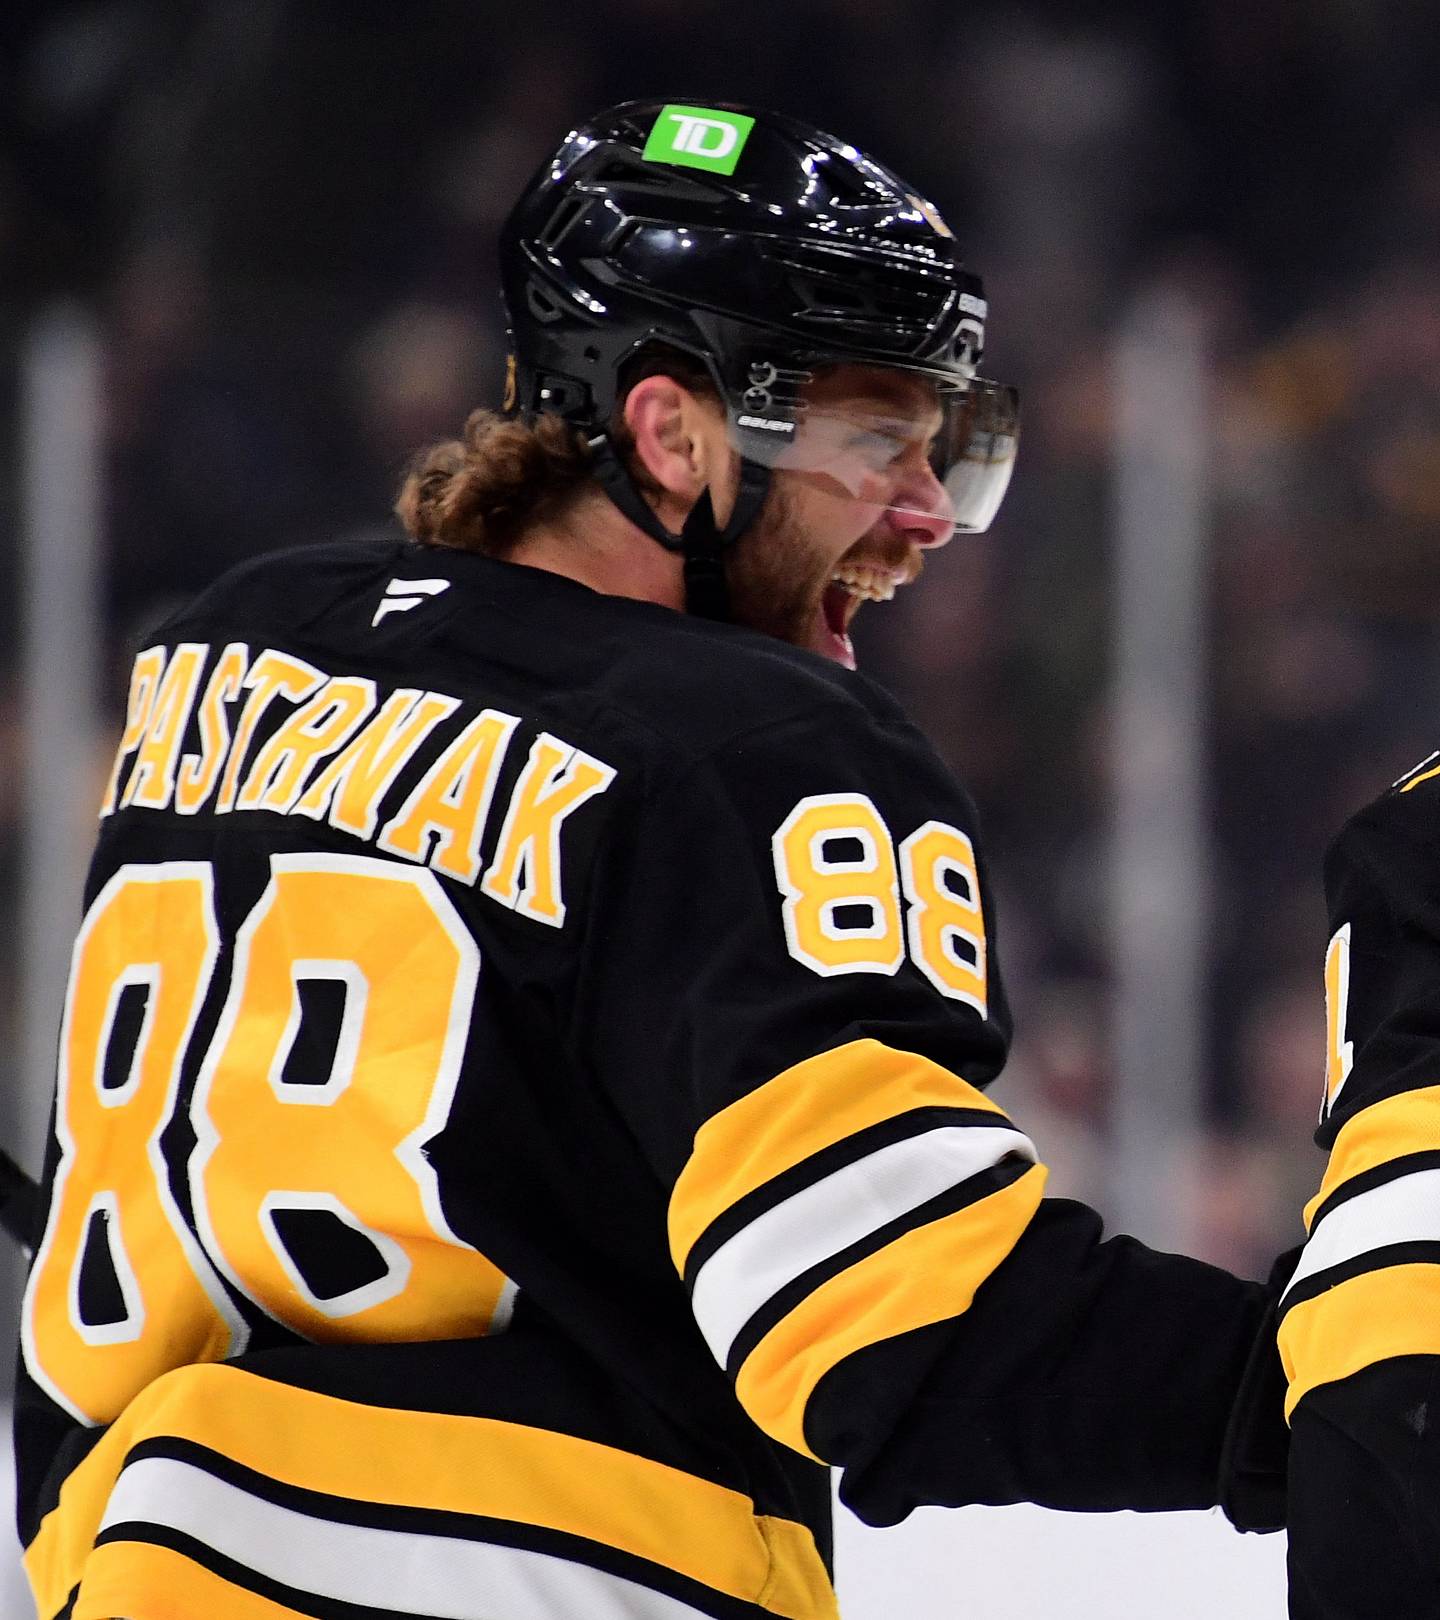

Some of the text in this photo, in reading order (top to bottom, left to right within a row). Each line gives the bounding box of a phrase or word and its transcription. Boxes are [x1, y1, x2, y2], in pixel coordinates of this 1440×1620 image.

[668, 113, 739, 159] TD
[737, 415, 795, 433] BAUER
[99, 642, 618, 929] PASTRNAK
[771, 792, 988, 1022] 88
[20, 852, 521, 1429] 88
